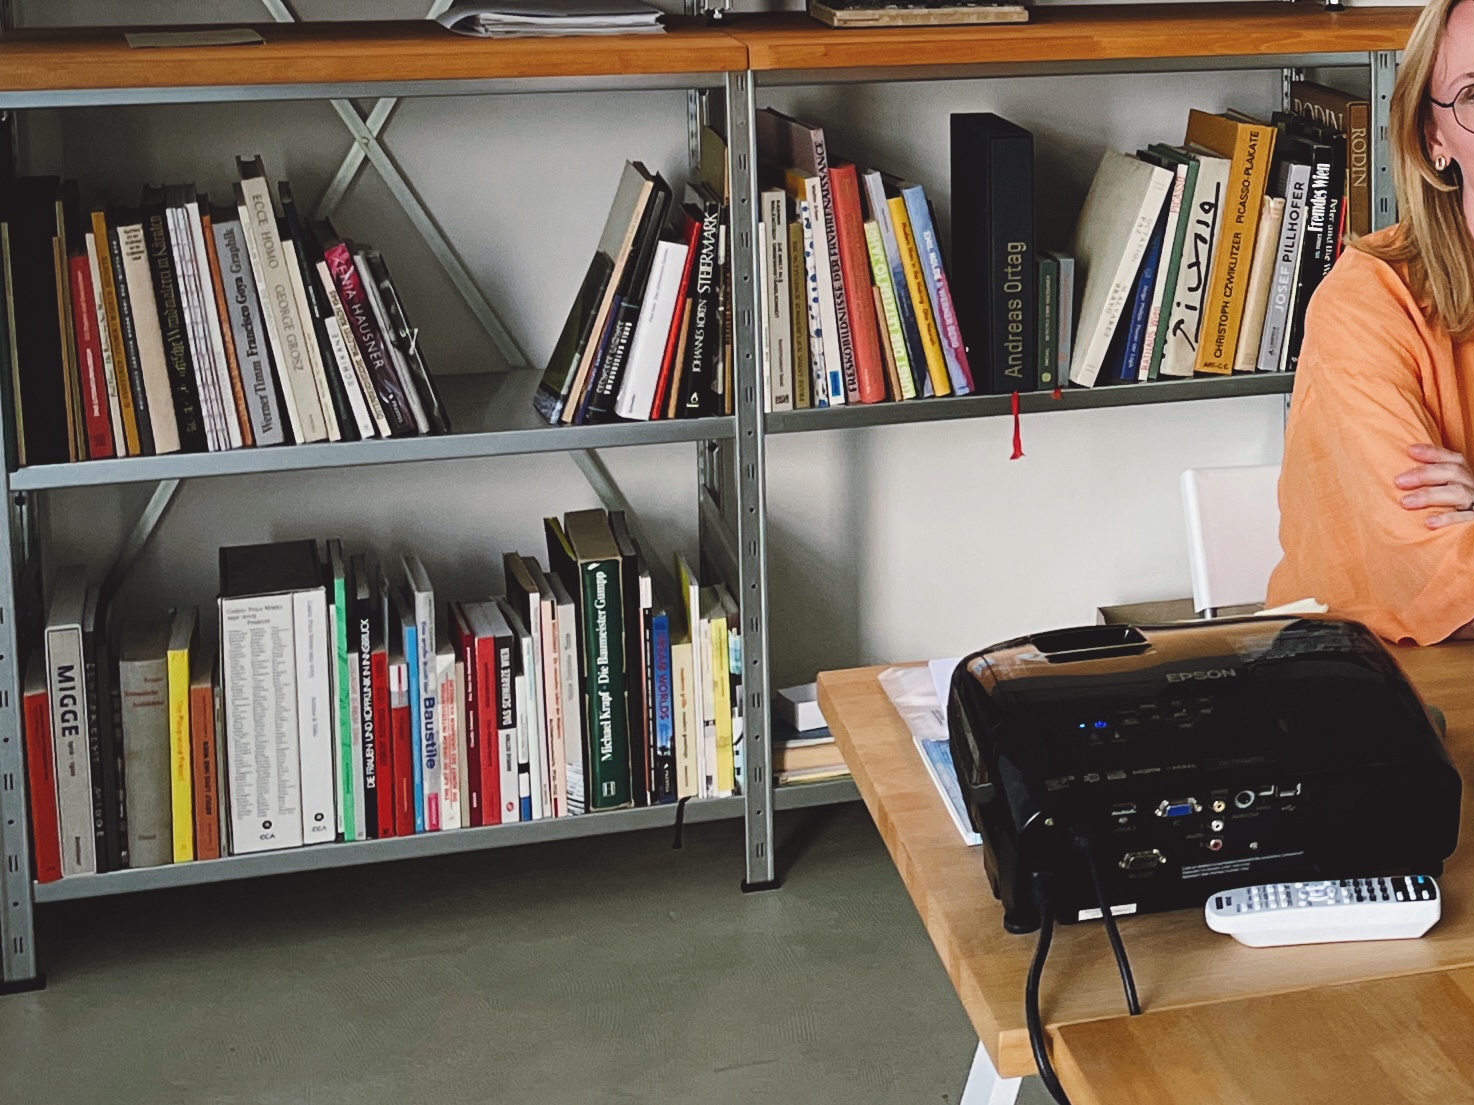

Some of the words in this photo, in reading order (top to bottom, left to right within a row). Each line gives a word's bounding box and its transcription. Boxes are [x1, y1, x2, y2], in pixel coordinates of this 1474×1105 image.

[1311, 161, 1330, 189] Wien
[1351, 127, 1366, 187] RODIN
[1170, 173, 1185, 212] PICASSO
[1307, 188, 1327, 231] Fremdes
[1281, 180, 1305, 263] PILLHOFER
[222, 227, 242, 273] Graphik
[696, 211, 718, 293] STEIERMARK
[829, 254, 842, 281] DER
[928, 252, 942, 280] NOLDE
[1003, 241, 1026, 292] Ortag
[232, 276, 248, 304] Goya
[252, 193, 266, 226] ECCE
[261, 231, 278, 269] HOMO
[274, 284, 293, 331] GEORGE
[285, 334, 303, 372] GROSZ
[1213, 300, 1231, 358] CHRISTOPH
[1223, 231, 1243, 298] CZWIKLITZER
[1273, 265, 1291, 311] JOSEF
[238, 305, 258, 357] Francisco
[332, 255, 357, 300] XENIA
[350, 303, 385, 370] HAUSNER
[691, 328, 705, 372] JOHANNES
[889, 333, 905, 358] DER
[1003, 298, 1023, 378] Andreas
[248, 360, 266, 393] Timm
[254, 393, 274, 433] Werner
[593, 570, 608, 608] Gumpp
[595, 610, 608, 664] Baumeister
[597, 665, 609, 683] Die
[1166, 668, 1237, 682] EPSON
[57, 665, 79, 738] MIGGE
[598, 691, 612, 718] Krapf
[658, 674, 668, 720] WORLDS
[364, 721, 374, 741] UND
[422, 696, 438, 768] Baustile
[600, 720, 612, 760] Michael
[365, 743, 375, 774] FRAUEN
